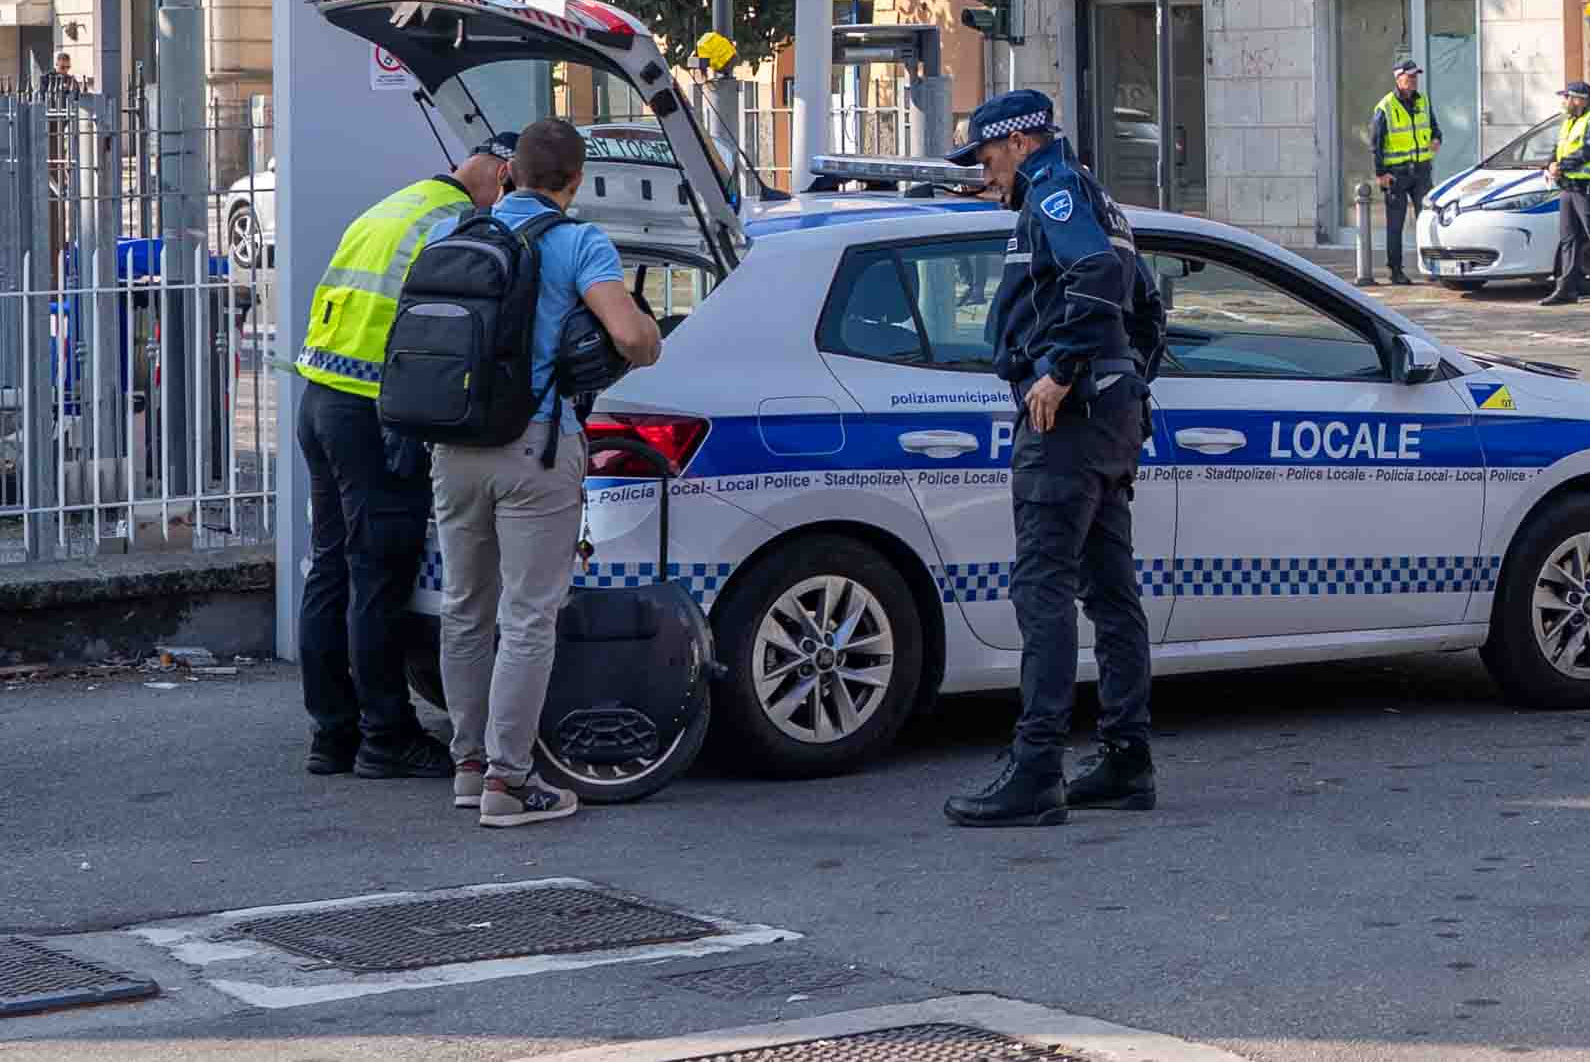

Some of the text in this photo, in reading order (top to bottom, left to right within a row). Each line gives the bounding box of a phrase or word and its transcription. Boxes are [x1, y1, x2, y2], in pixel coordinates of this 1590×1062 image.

[1270, 420, 1423, 459] LOCALE
[717, 478, 759, 493] Local
[764, 475, 810, 490] Police
[917, 471, 960, 485] Police
[964, 470, 1008, 485] Locale
[1155, 466, 1193, 481] Police
[1205, 466, 1277, 482] Stadtpolizei
[1286, 467, 1323, 481] Police
[1327, 468, 1366, 481] Locale
[1489, 468, 1525, 482] Police
